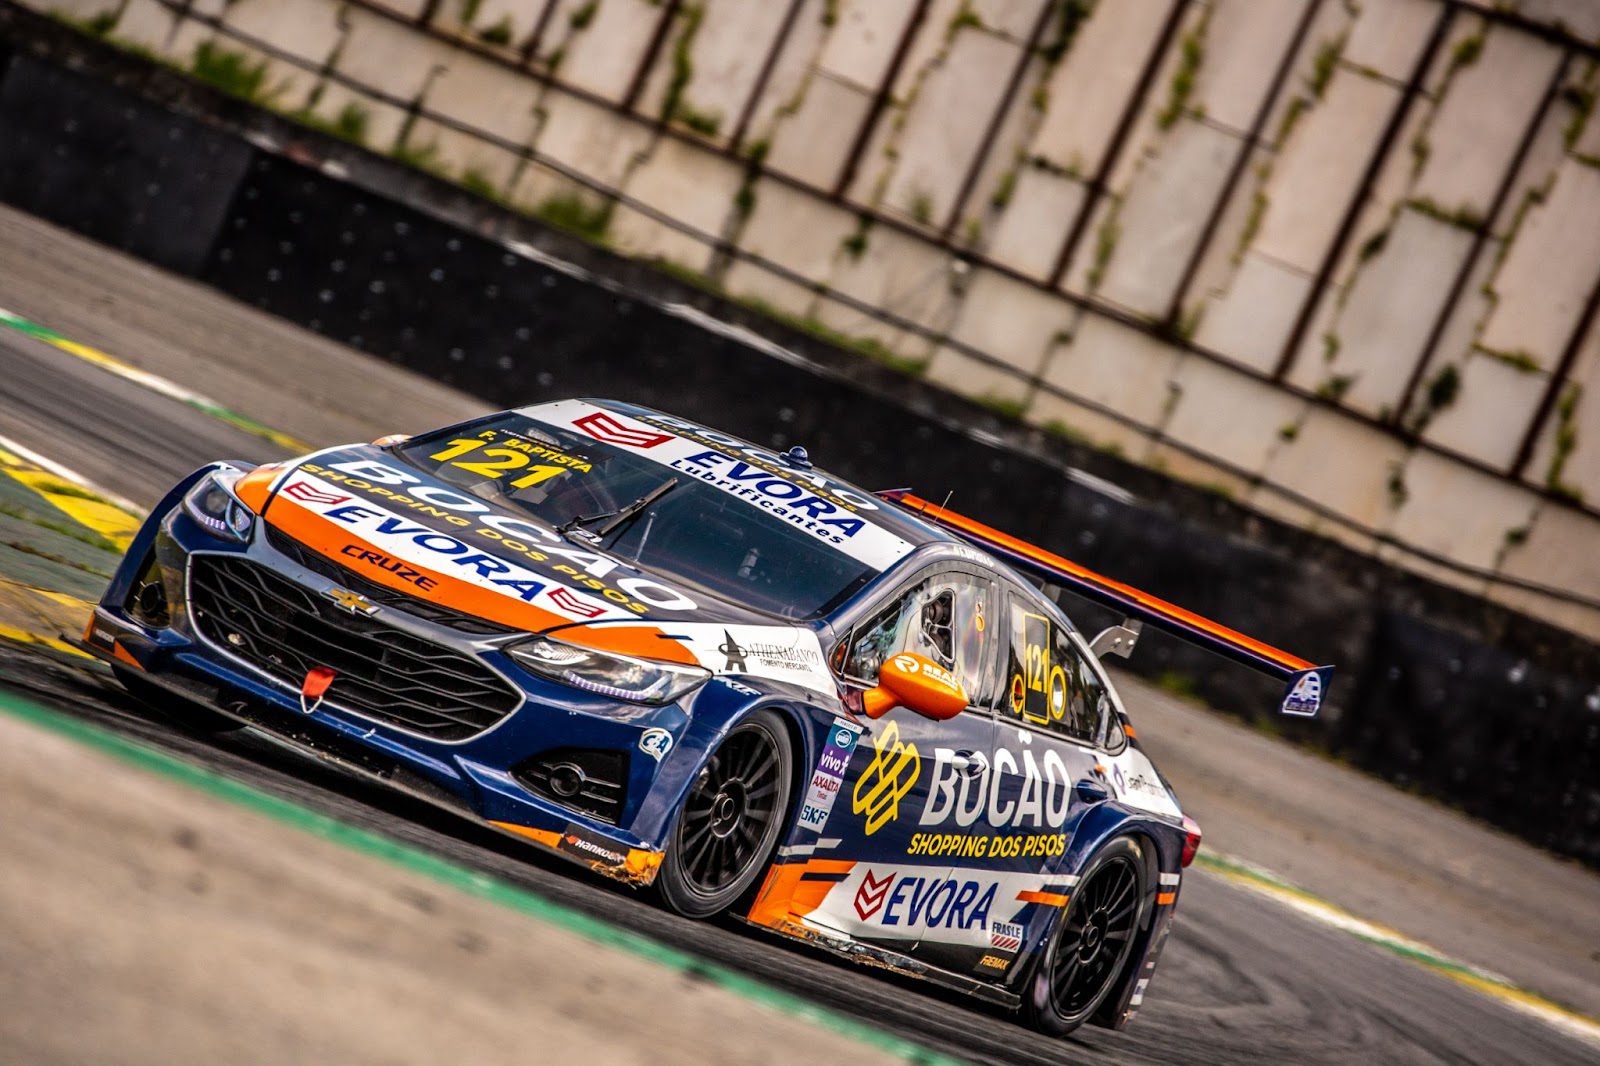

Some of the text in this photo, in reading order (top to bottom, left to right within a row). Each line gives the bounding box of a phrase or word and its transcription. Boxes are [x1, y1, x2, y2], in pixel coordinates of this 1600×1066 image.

[429, 438, 568, 489] 121
[478, 430, 498, 441] F.
[502, 438, 593, 473] BAPTISTA
[669, 459, 844, 545] Lubrificantes
[683, 450, 867, 538] EVORA
[745, 457, 792, 479] DOS
[794, 480, 858, 513] PISOS
[298, 463, 650, 614] SHOPPING DOS PISOS
[322, 505, 547, 602] EVORA
[340, 544, 439, 592] CRUZE
[1026, 643, 1049, 695] 121
[812, 775, 839, 792] AXALTA
[821, 750, 841, 770] vivo
[918, 730, 1072, 828] BOCÃO
[800, 805, 829, 825] SKF
[907, 833, 1066, 858] SHOPPING DOS PISOS
[881, 876, 999, 930] EVORA
